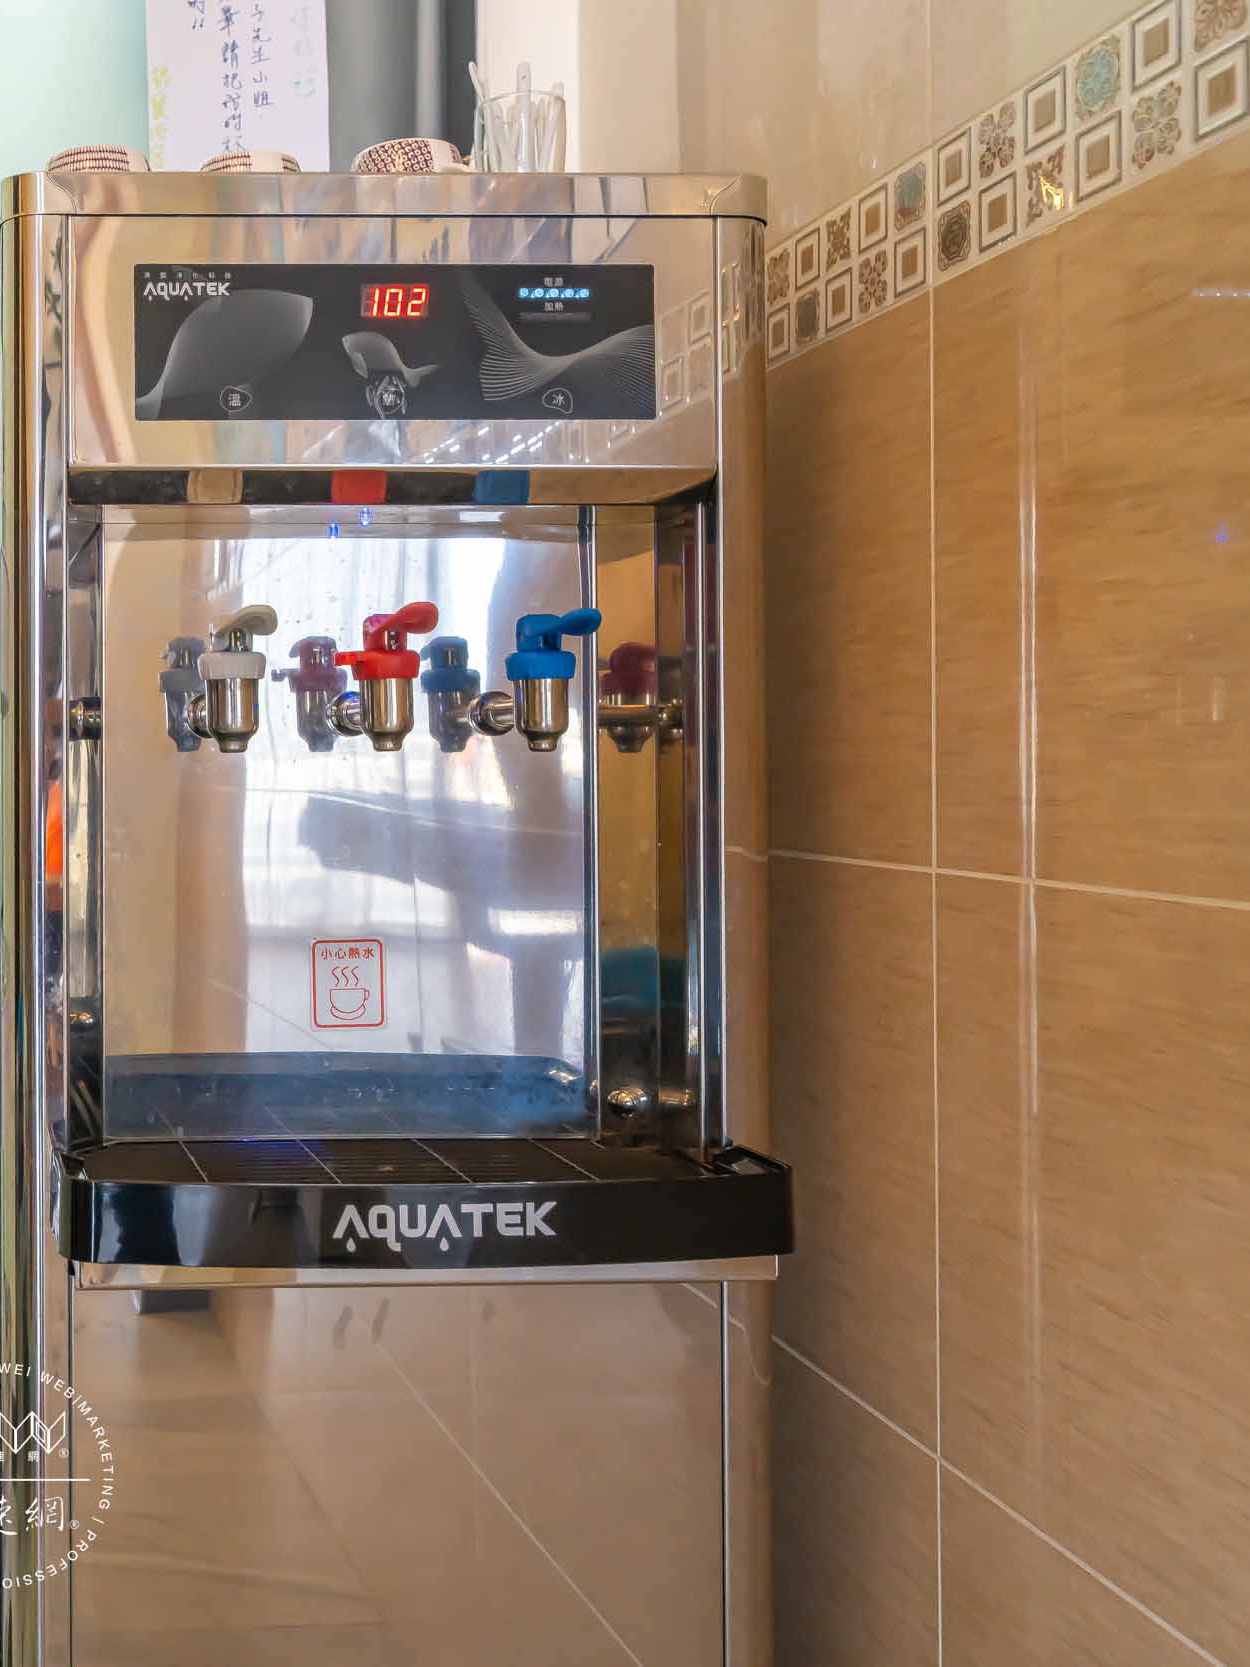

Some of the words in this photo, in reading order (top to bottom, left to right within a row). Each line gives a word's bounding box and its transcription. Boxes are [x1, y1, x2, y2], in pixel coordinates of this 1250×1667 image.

[143, 281, 230, 301] AQUATEK
[372, 287, 426, 317] 102
[321, 946, 374, 960] 小心熱水
[332, 1201, 558, 1253] AQUATEK
